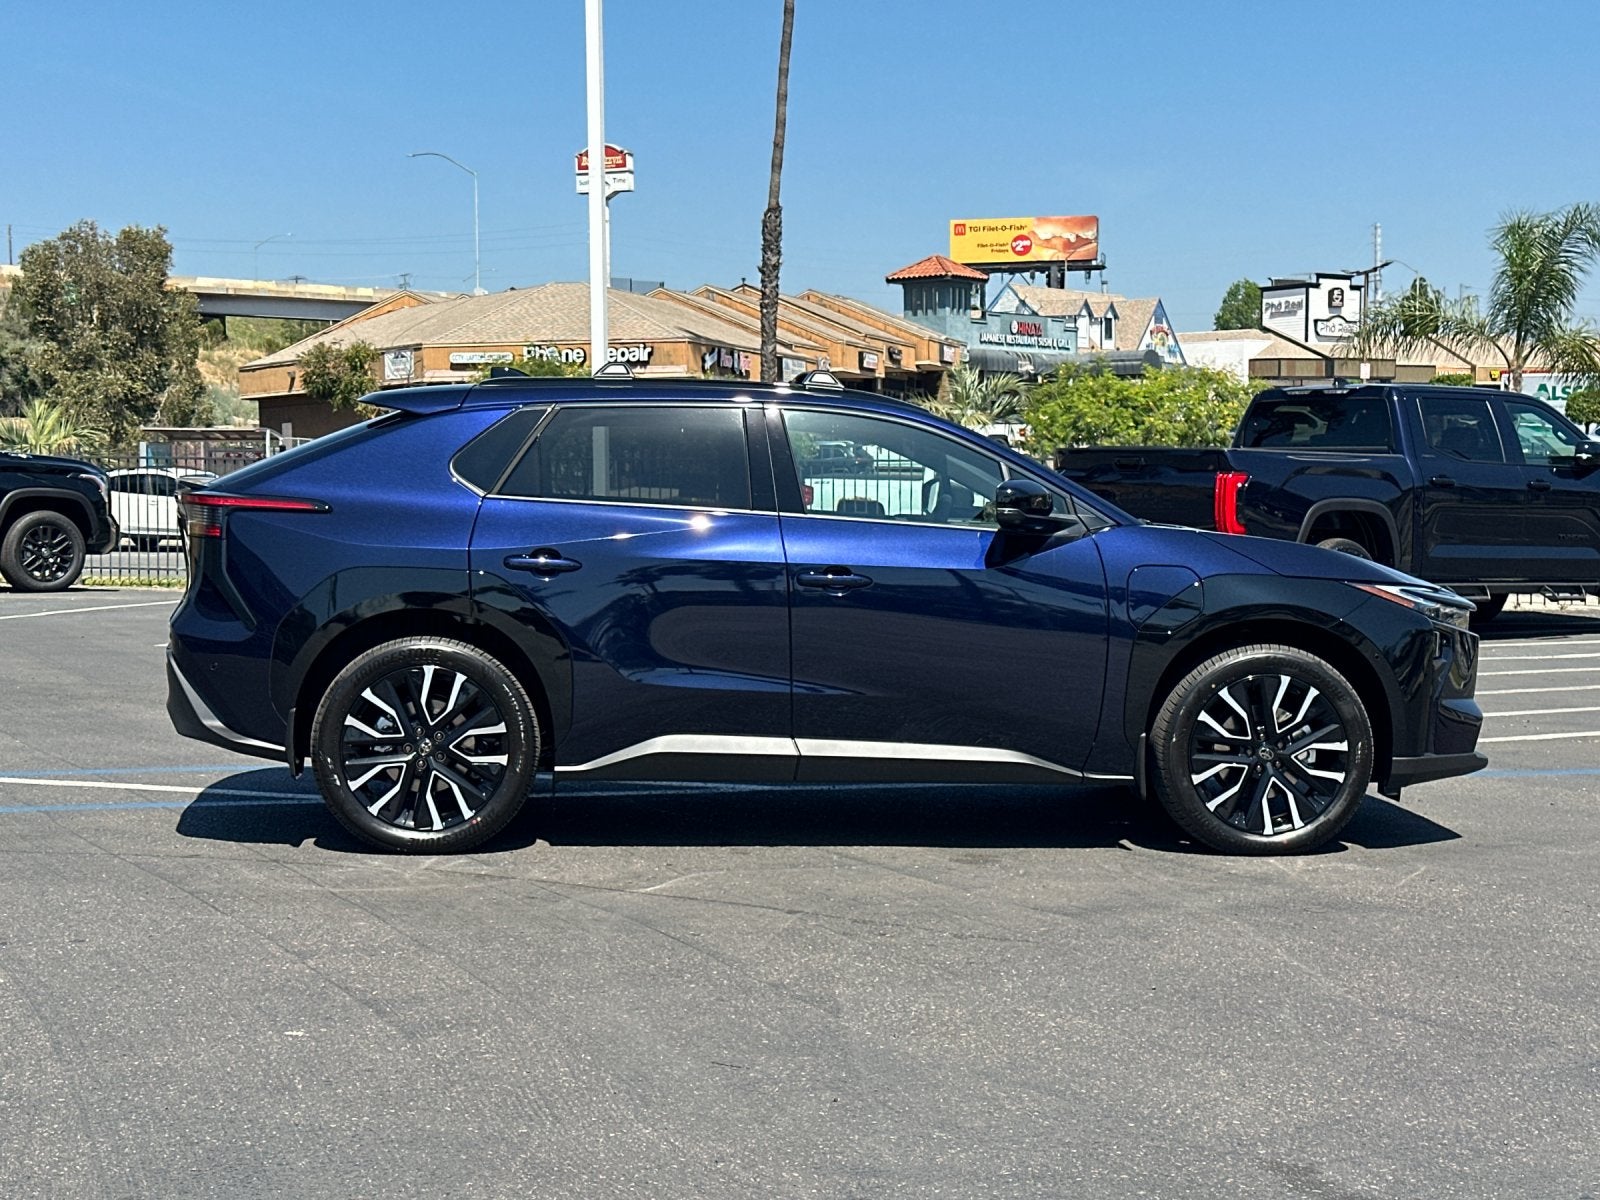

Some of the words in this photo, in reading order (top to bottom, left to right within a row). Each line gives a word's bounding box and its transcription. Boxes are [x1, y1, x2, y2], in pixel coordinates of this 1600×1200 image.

[1284, 298, 1303, 311] Real
[980, 332, 1005, 345] JAPANESE
[1006, 334, 1038, 346] RESTAURANT
[607, 343, 652, 364] epair
